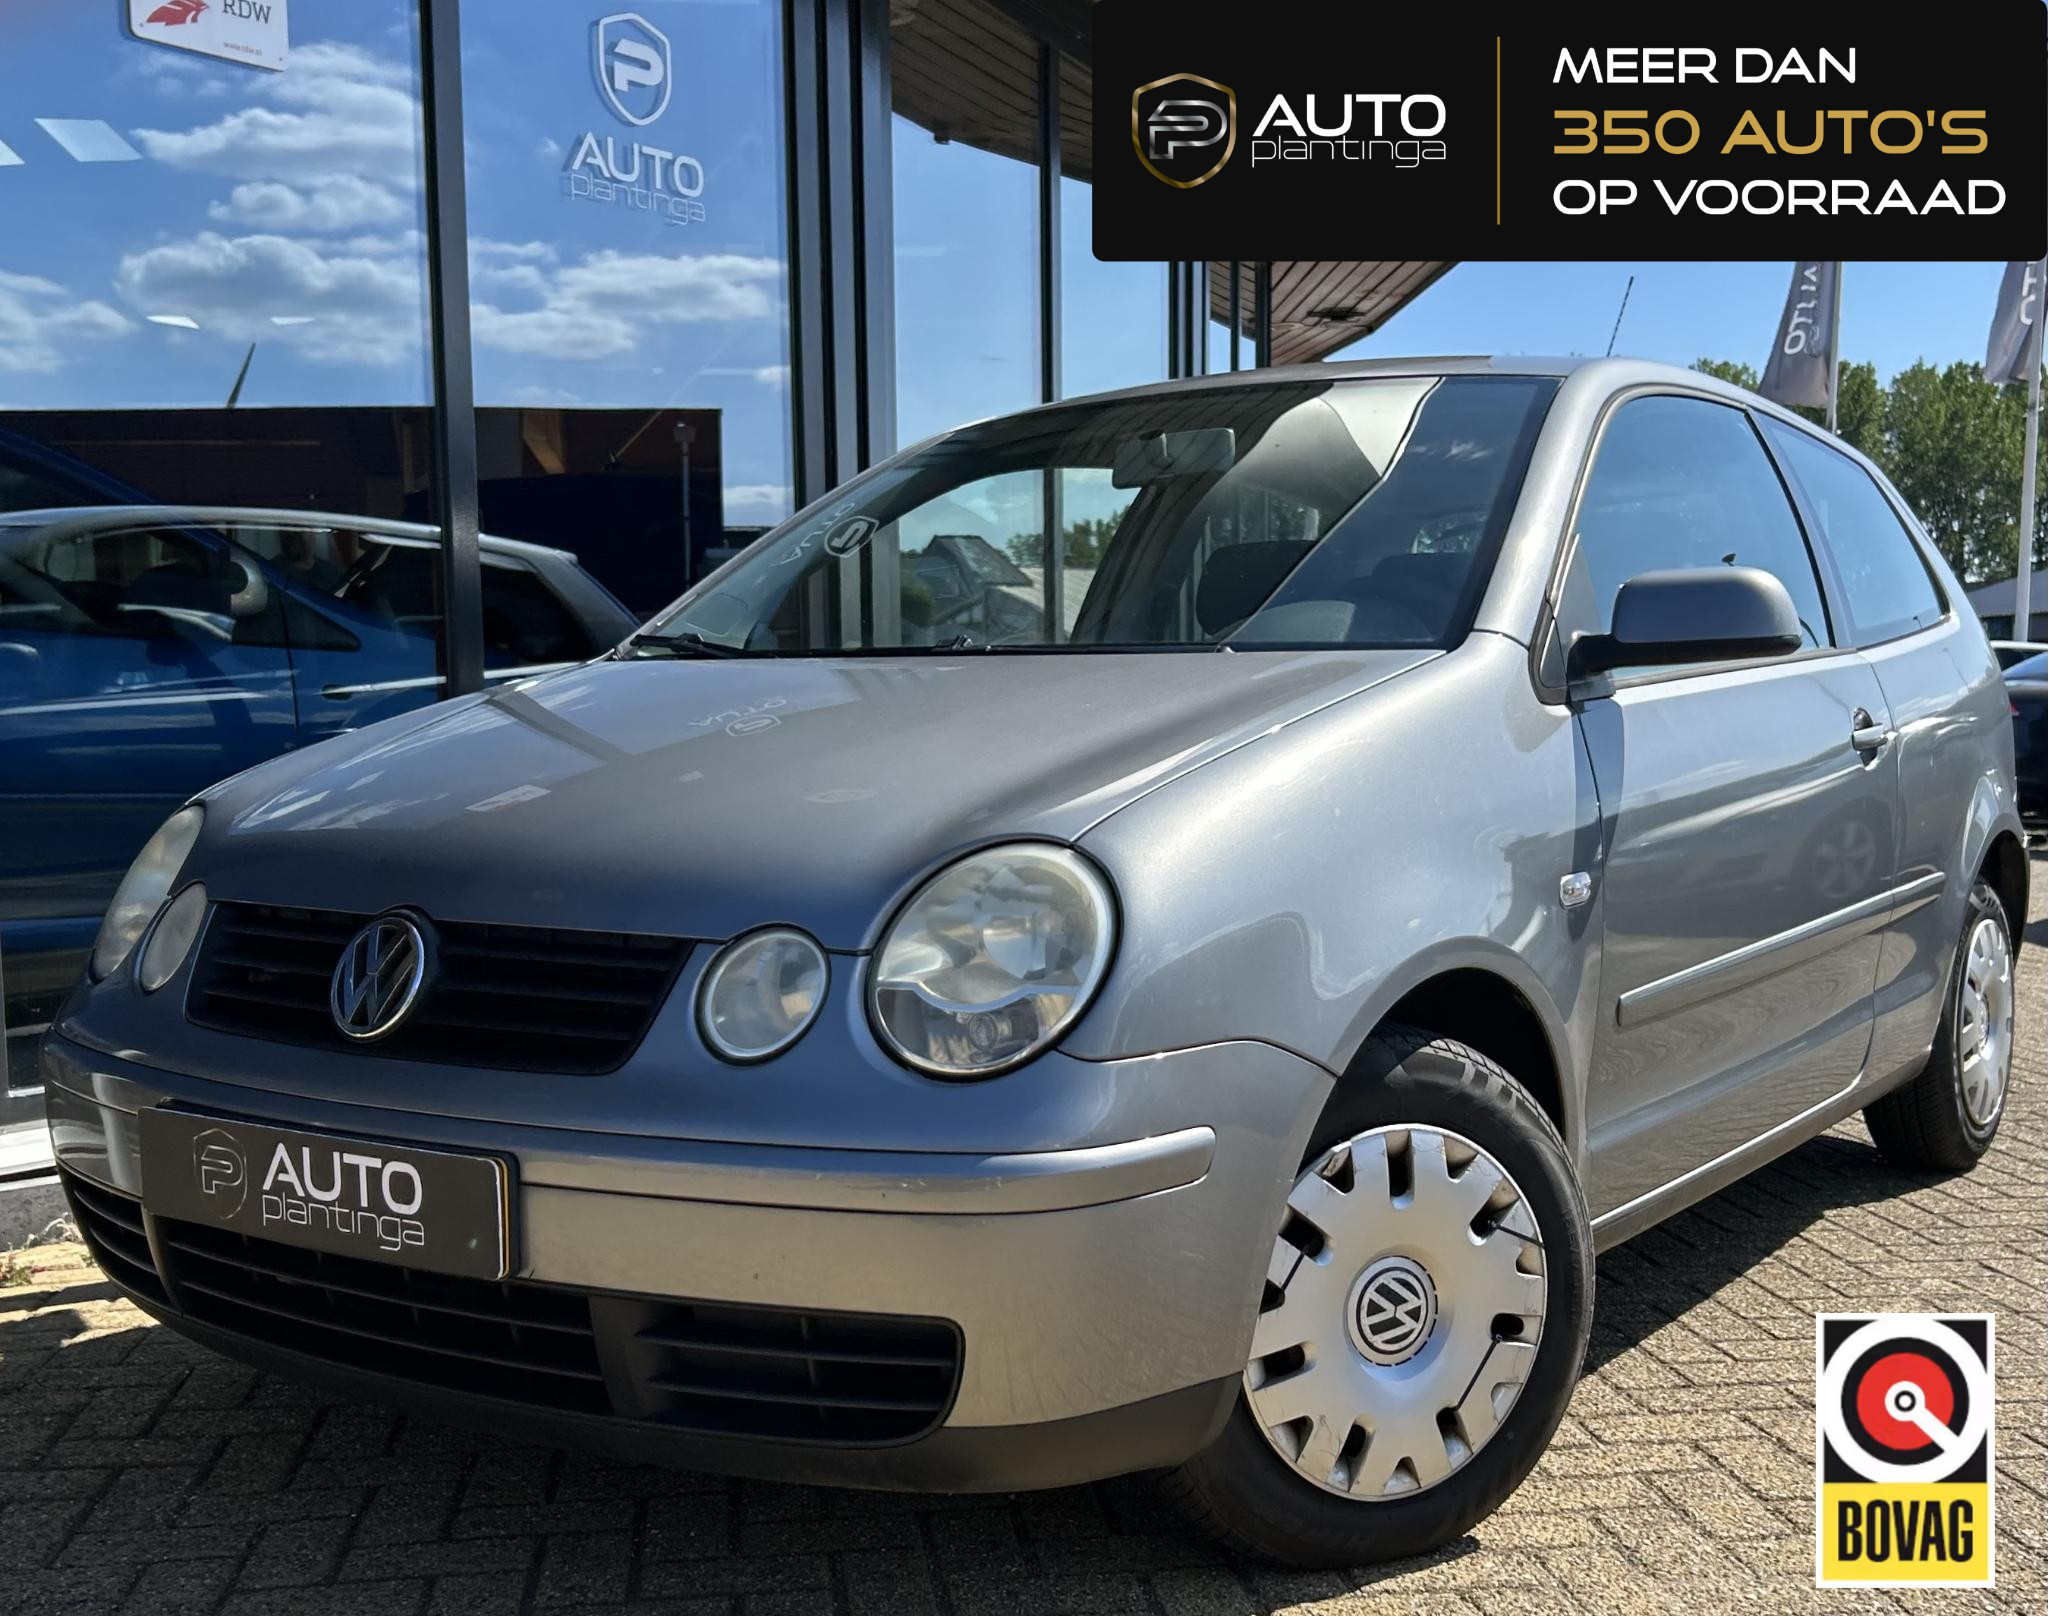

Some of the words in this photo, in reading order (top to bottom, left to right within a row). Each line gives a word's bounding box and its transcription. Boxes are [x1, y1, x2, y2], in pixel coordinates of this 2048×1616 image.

[222, 0, 271, 24] RDW
[571, 131, 704, 198] AUTO
[570, 173, 706, 226] plantinga
[262, 1142, 423, 1216] AUTO
[262, 1192, 425, 1251] plantinga
